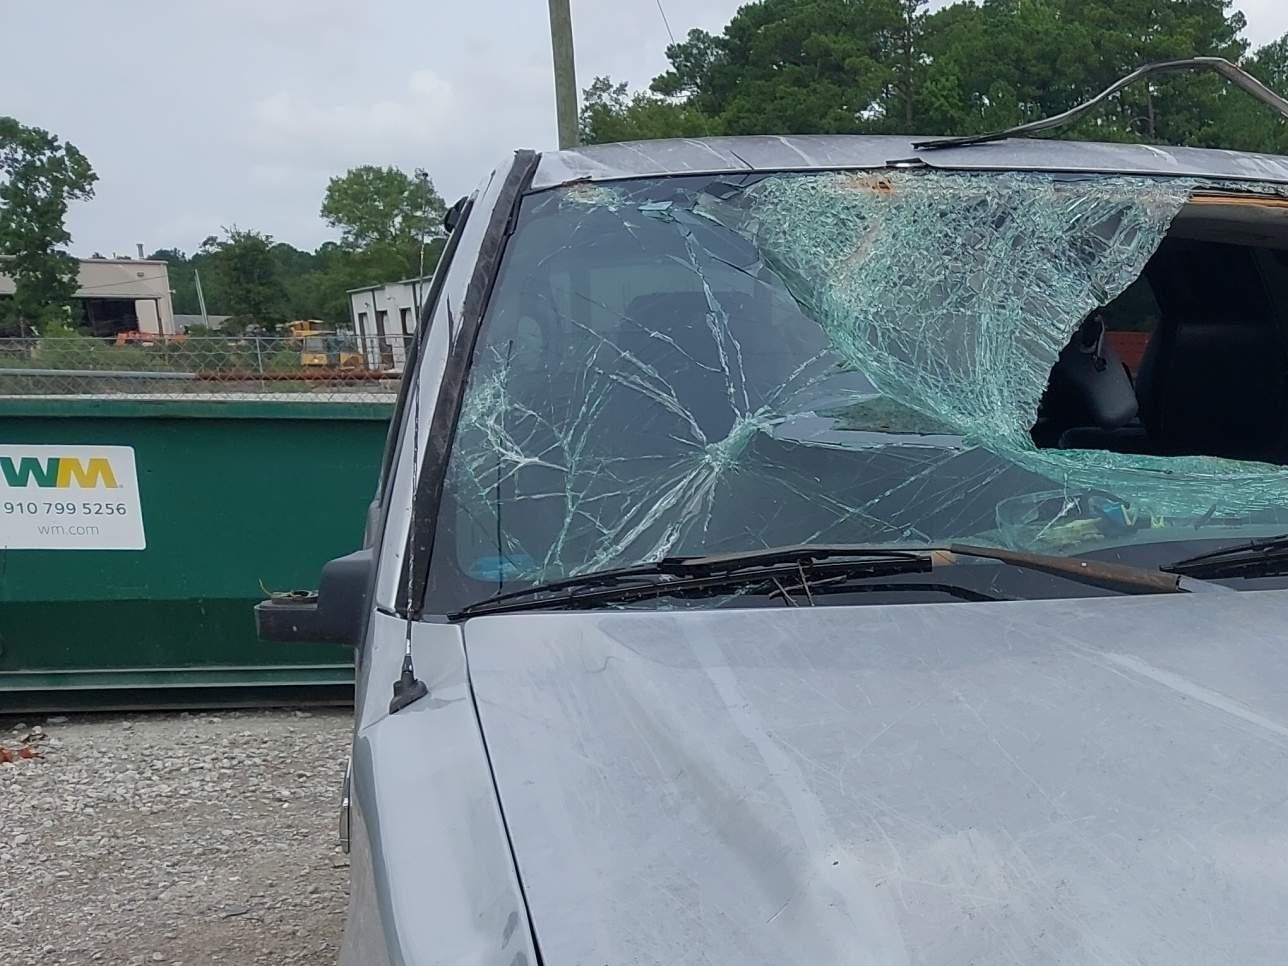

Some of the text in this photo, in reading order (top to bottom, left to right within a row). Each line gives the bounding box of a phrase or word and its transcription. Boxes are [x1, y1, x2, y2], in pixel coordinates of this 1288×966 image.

[0, 457, 118, 488] WM
[4, 502, 127, 515] 910 799 5256
[38, 525, 99, 536] wm.com
